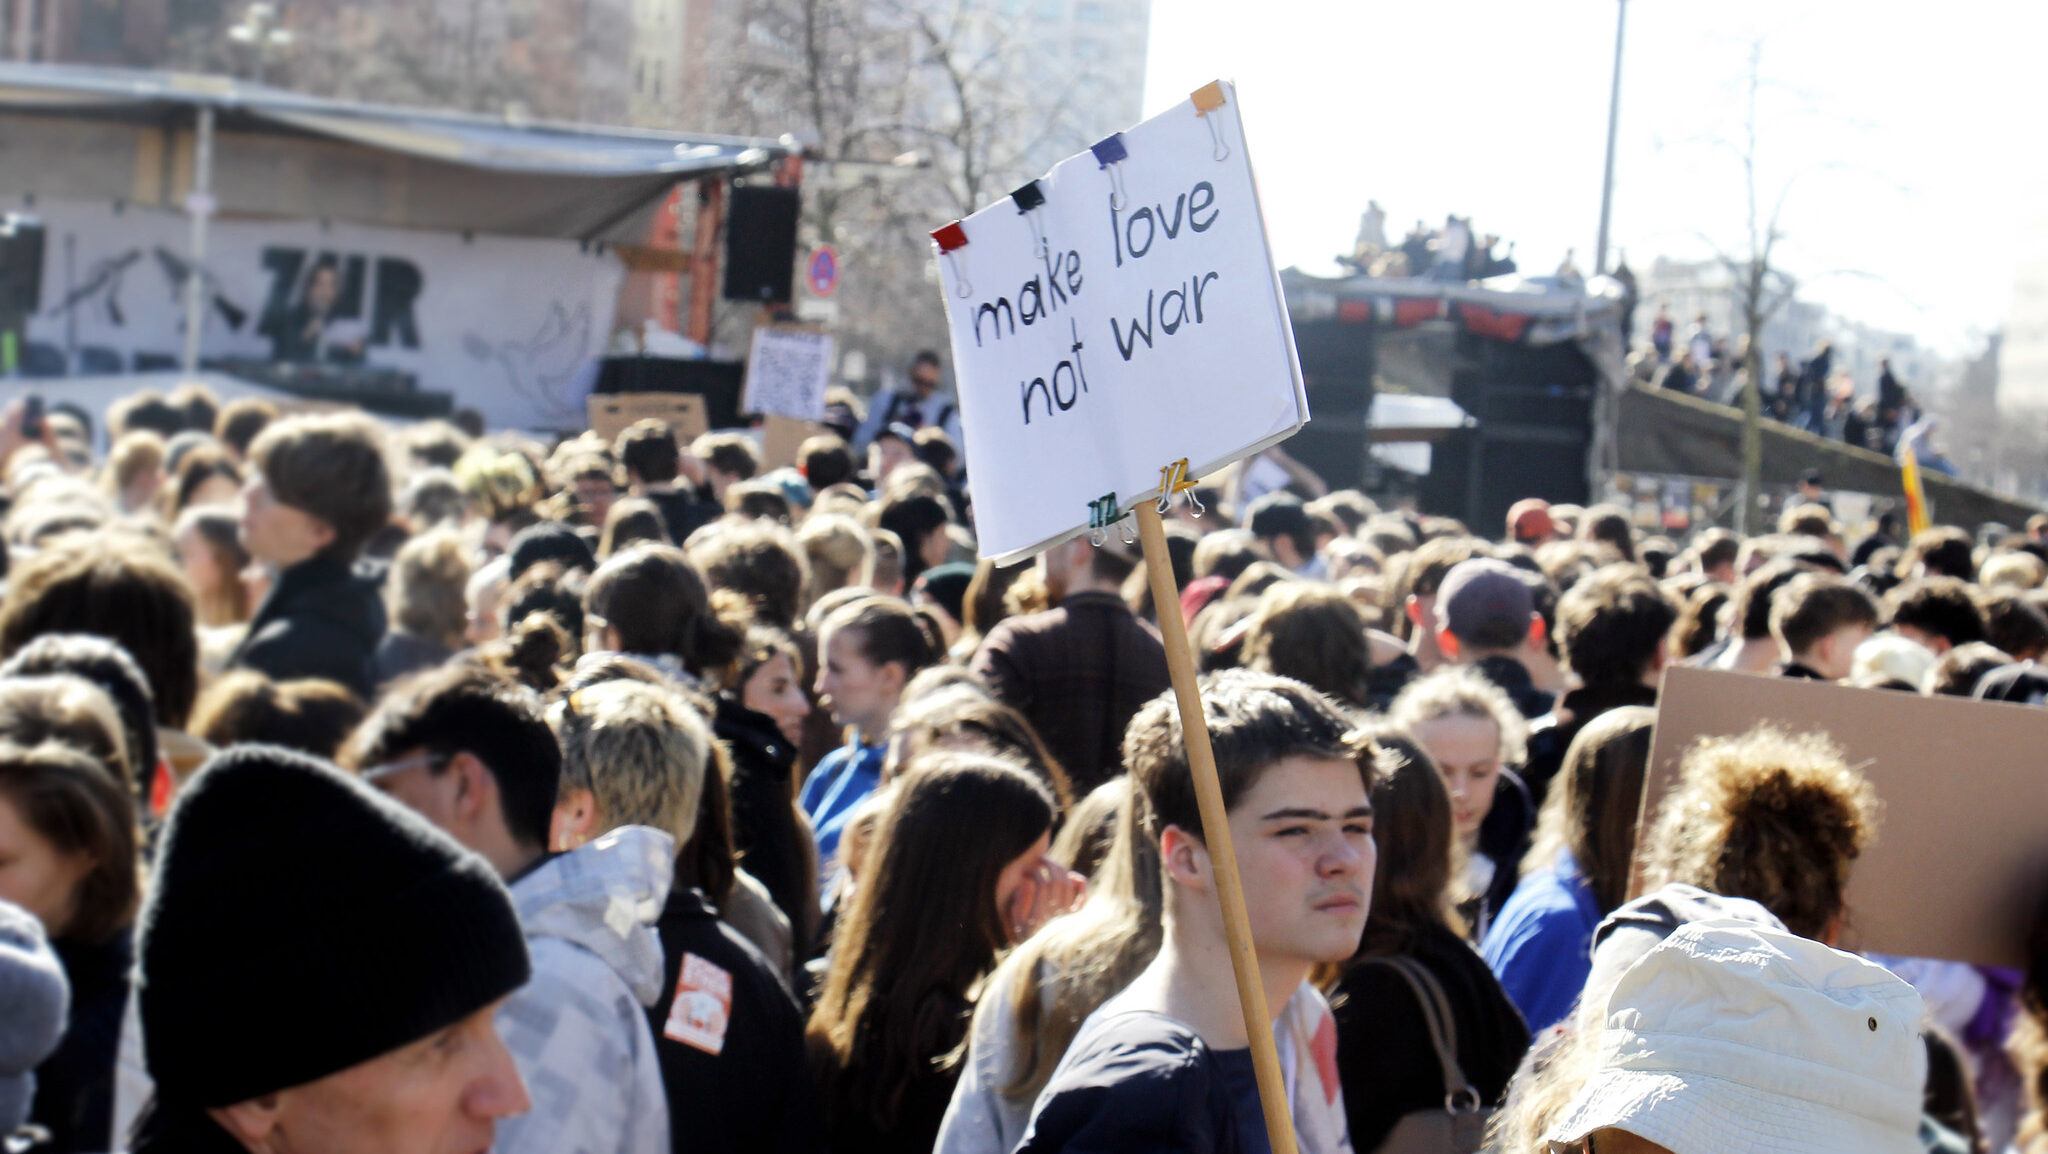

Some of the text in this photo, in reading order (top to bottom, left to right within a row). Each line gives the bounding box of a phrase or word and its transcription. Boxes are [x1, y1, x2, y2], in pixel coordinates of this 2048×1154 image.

[970, 180, 1220, 347] make love
[1020, 271, 1219, 425] not war
